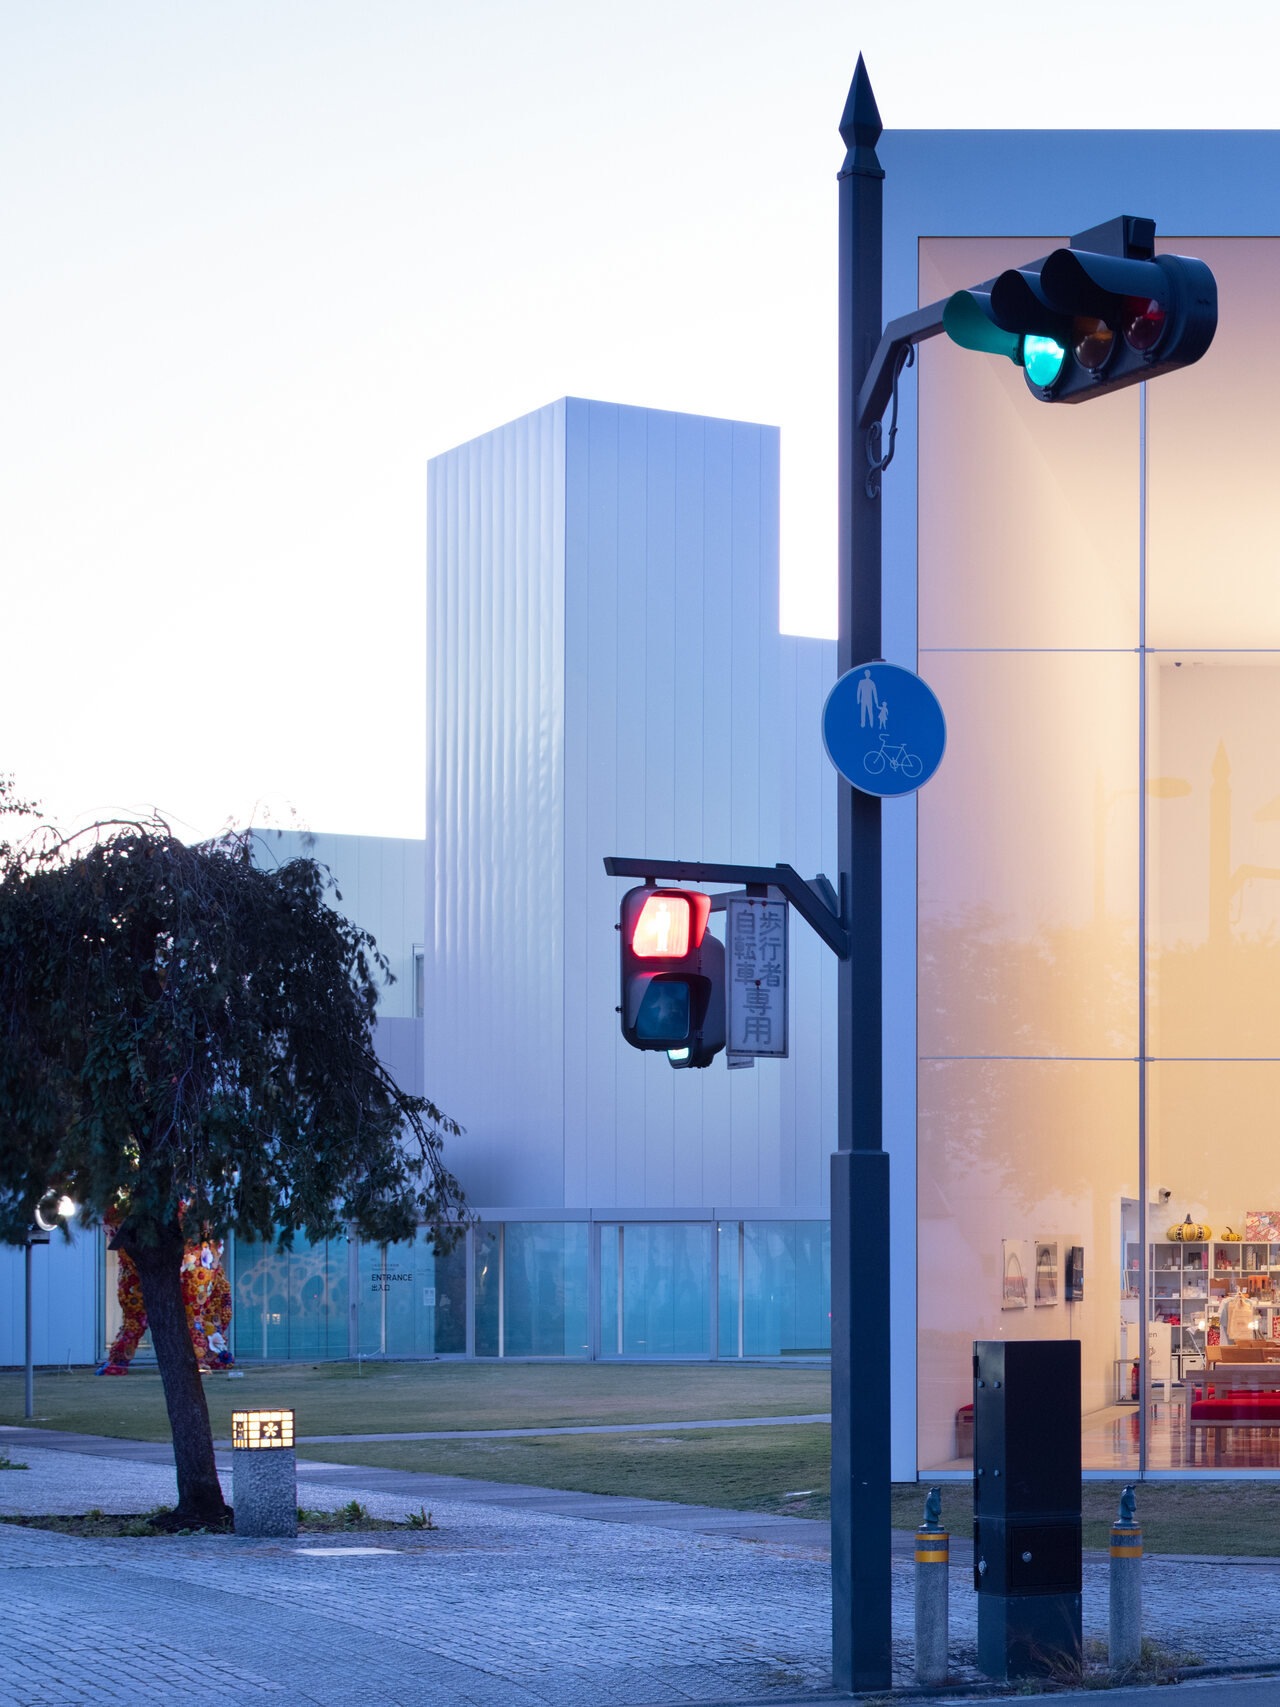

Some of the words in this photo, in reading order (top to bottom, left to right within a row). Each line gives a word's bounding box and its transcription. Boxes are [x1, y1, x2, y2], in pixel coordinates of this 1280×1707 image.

[734, 909, 758, 986] 自転車
[758, 911, 782, 988] 歩行者
[742, 987, 772, 1045] 専用
[371, 1273, 413, 1281] ENTRANCE
